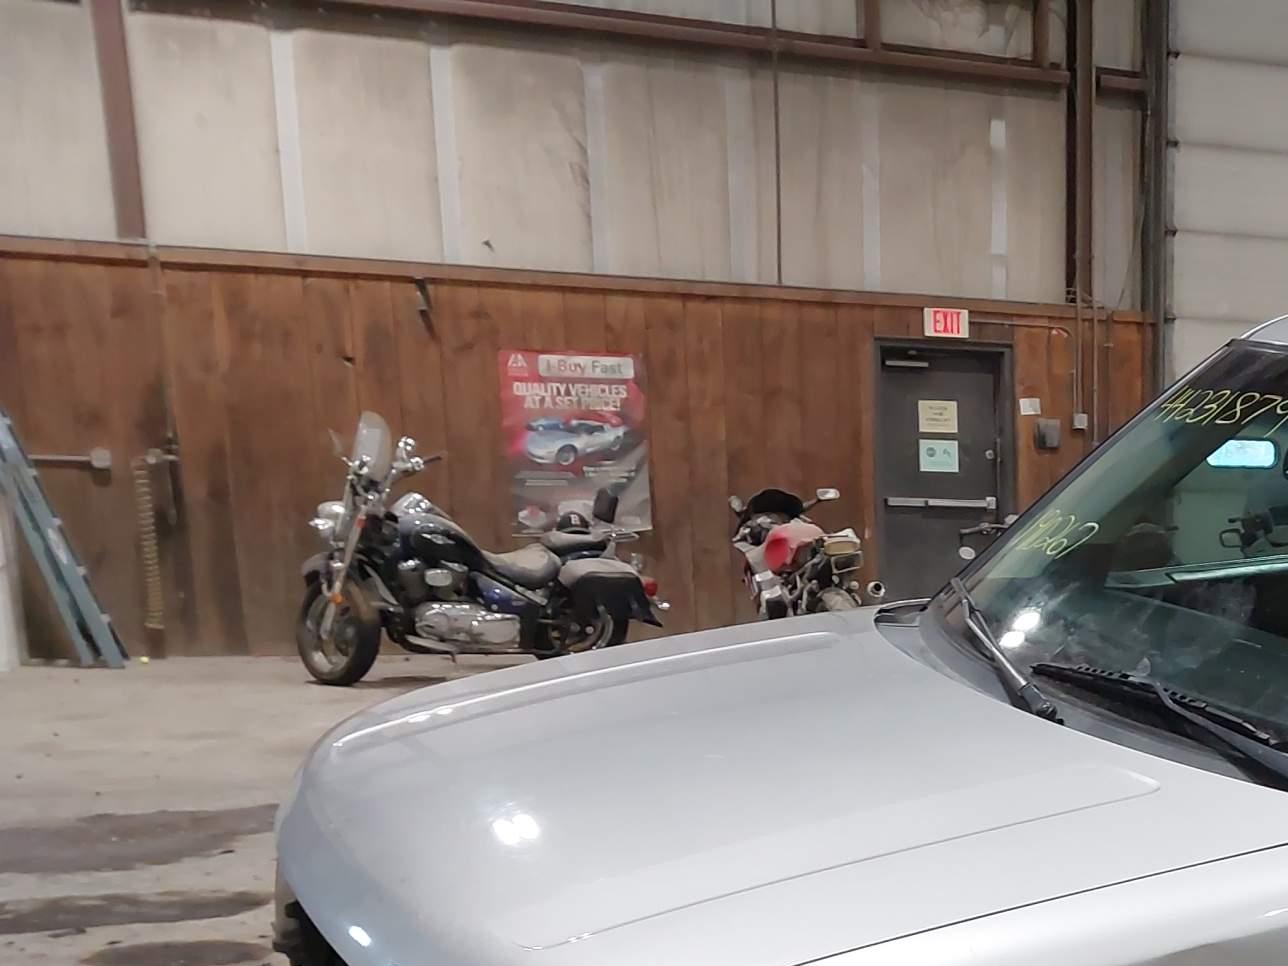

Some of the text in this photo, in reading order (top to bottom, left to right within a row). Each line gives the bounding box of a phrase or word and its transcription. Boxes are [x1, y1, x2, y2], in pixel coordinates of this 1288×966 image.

[932, 310, 962, 335] EXIT
[591, 360, 623, 375] Fast
[513, 382, 628, 398] QUALITY VEHICLES
[524, 395, 543, 409] AT
[544, 396, 554, 409] A
[555, 396, 579, 409] SET
